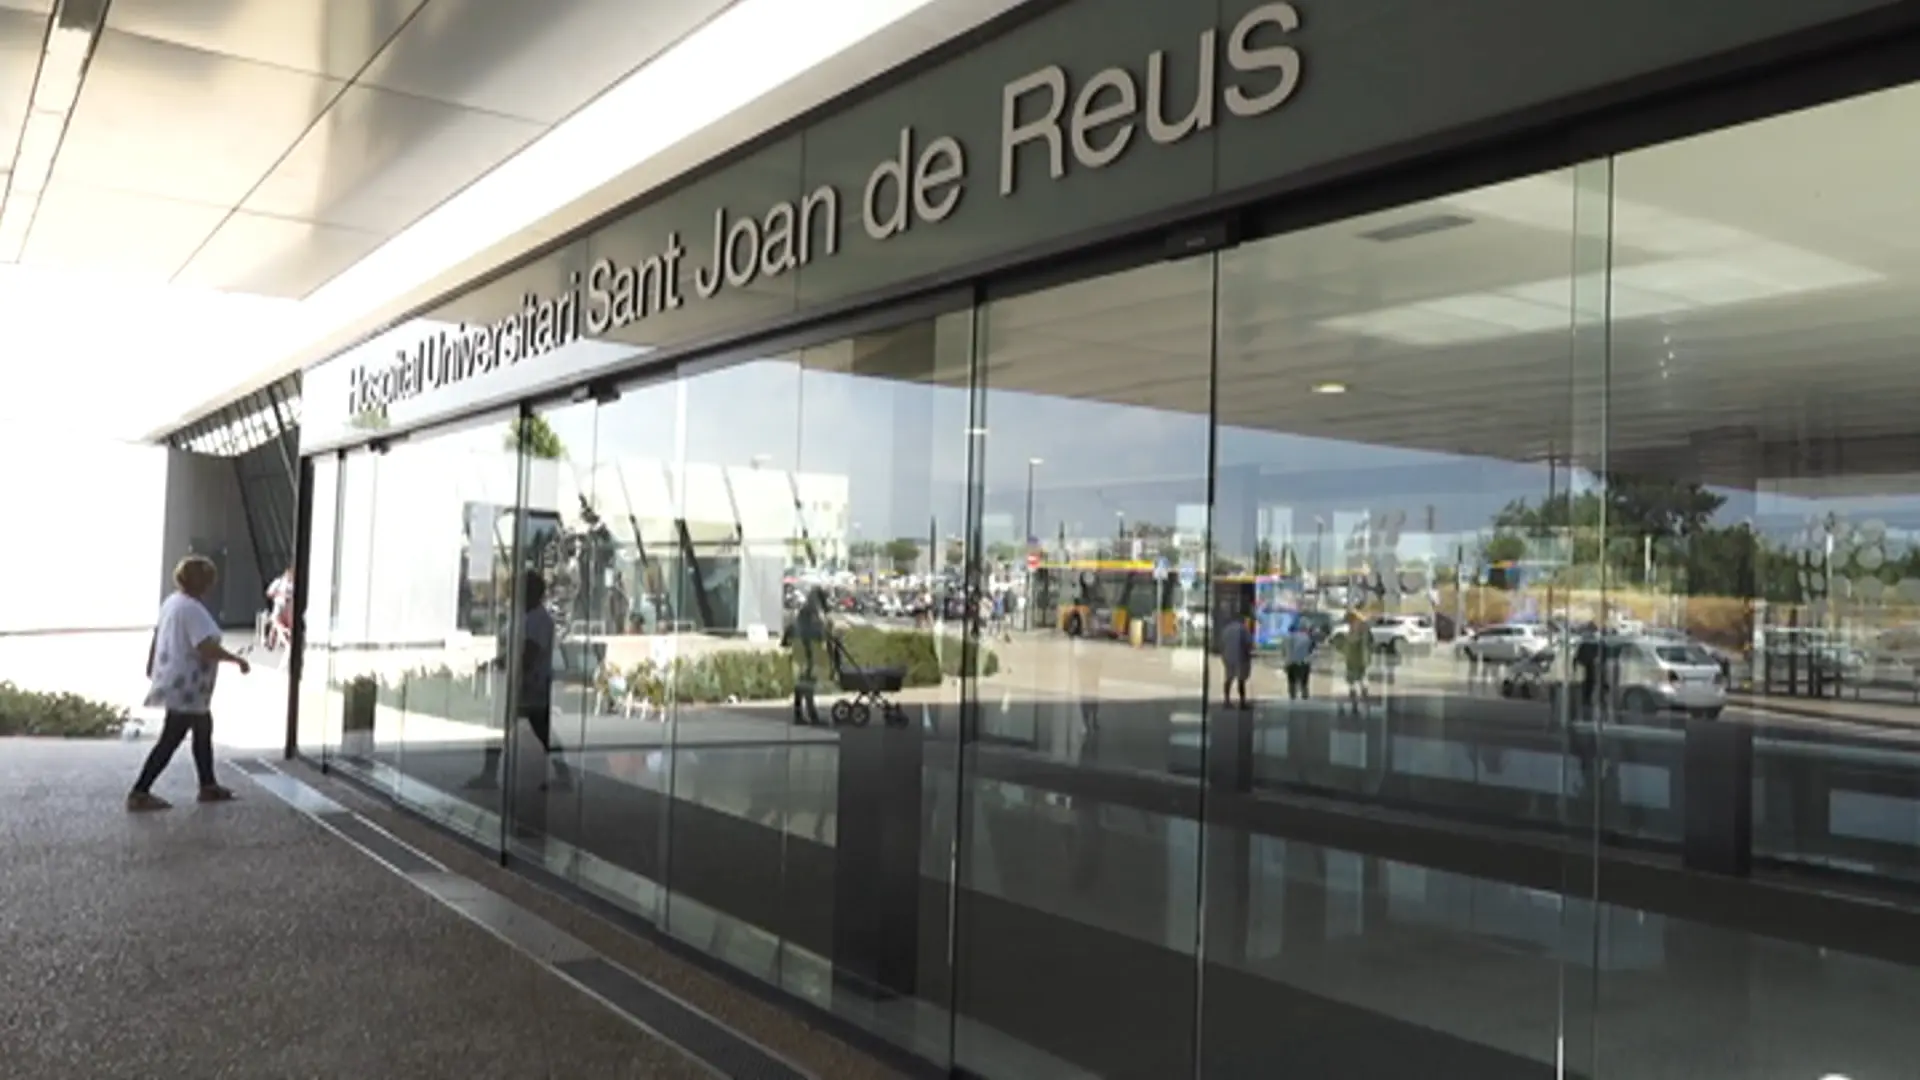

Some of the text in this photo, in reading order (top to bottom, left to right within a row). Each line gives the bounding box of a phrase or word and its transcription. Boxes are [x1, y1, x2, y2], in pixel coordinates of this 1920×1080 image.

[349, 1, 1303, 419] Hospital Universitari Sant Joan de Reus
